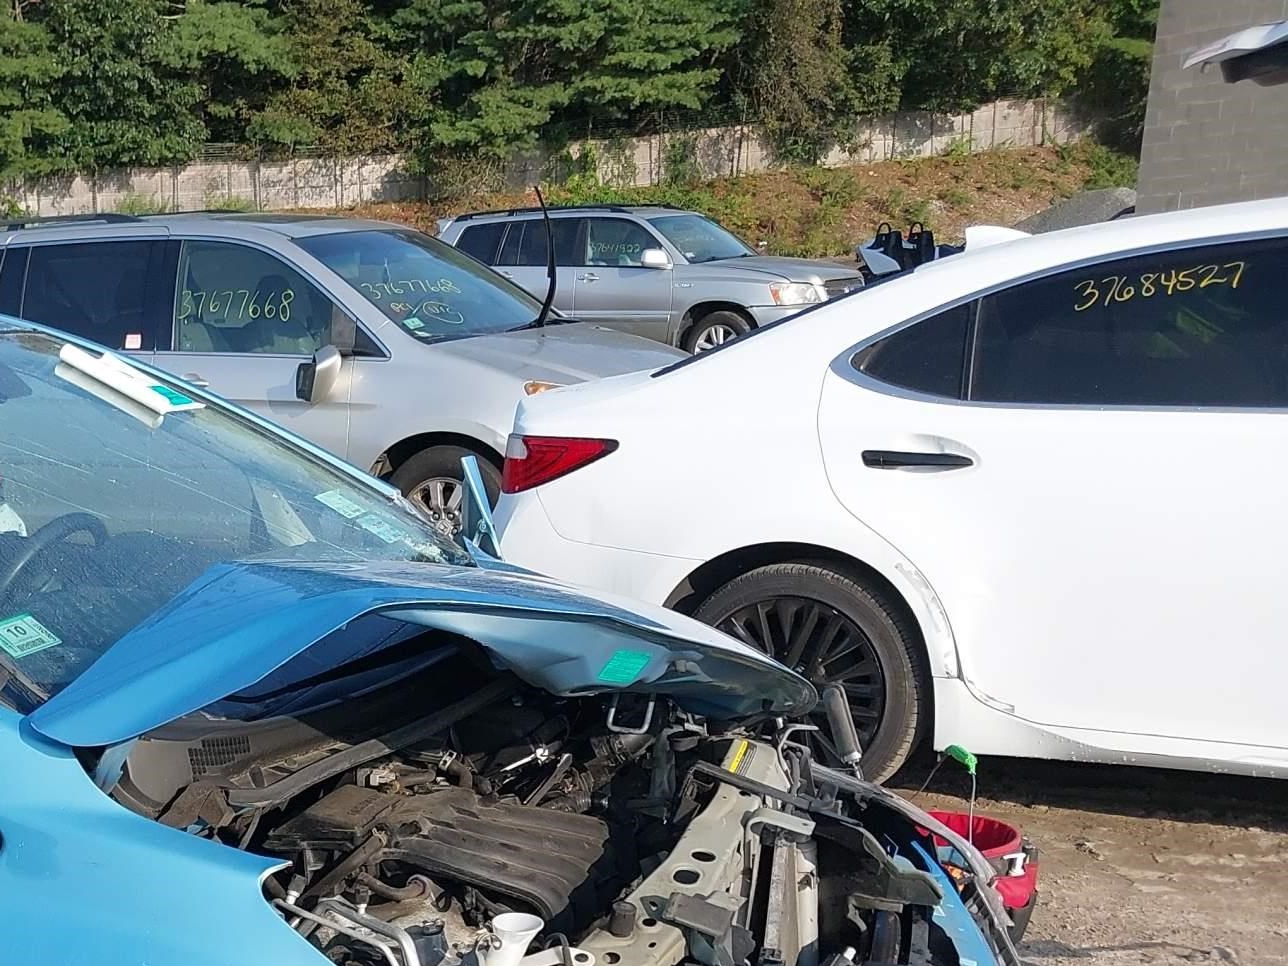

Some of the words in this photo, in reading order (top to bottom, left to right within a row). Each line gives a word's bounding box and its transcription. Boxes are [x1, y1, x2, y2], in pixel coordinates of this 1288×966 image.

[361, 279, 462, 299] 37677668
[1074, 262, 1245, 311] 37684527
[178, 289, 295, 322] 37677668
[6, 625, 27, 638] 10
